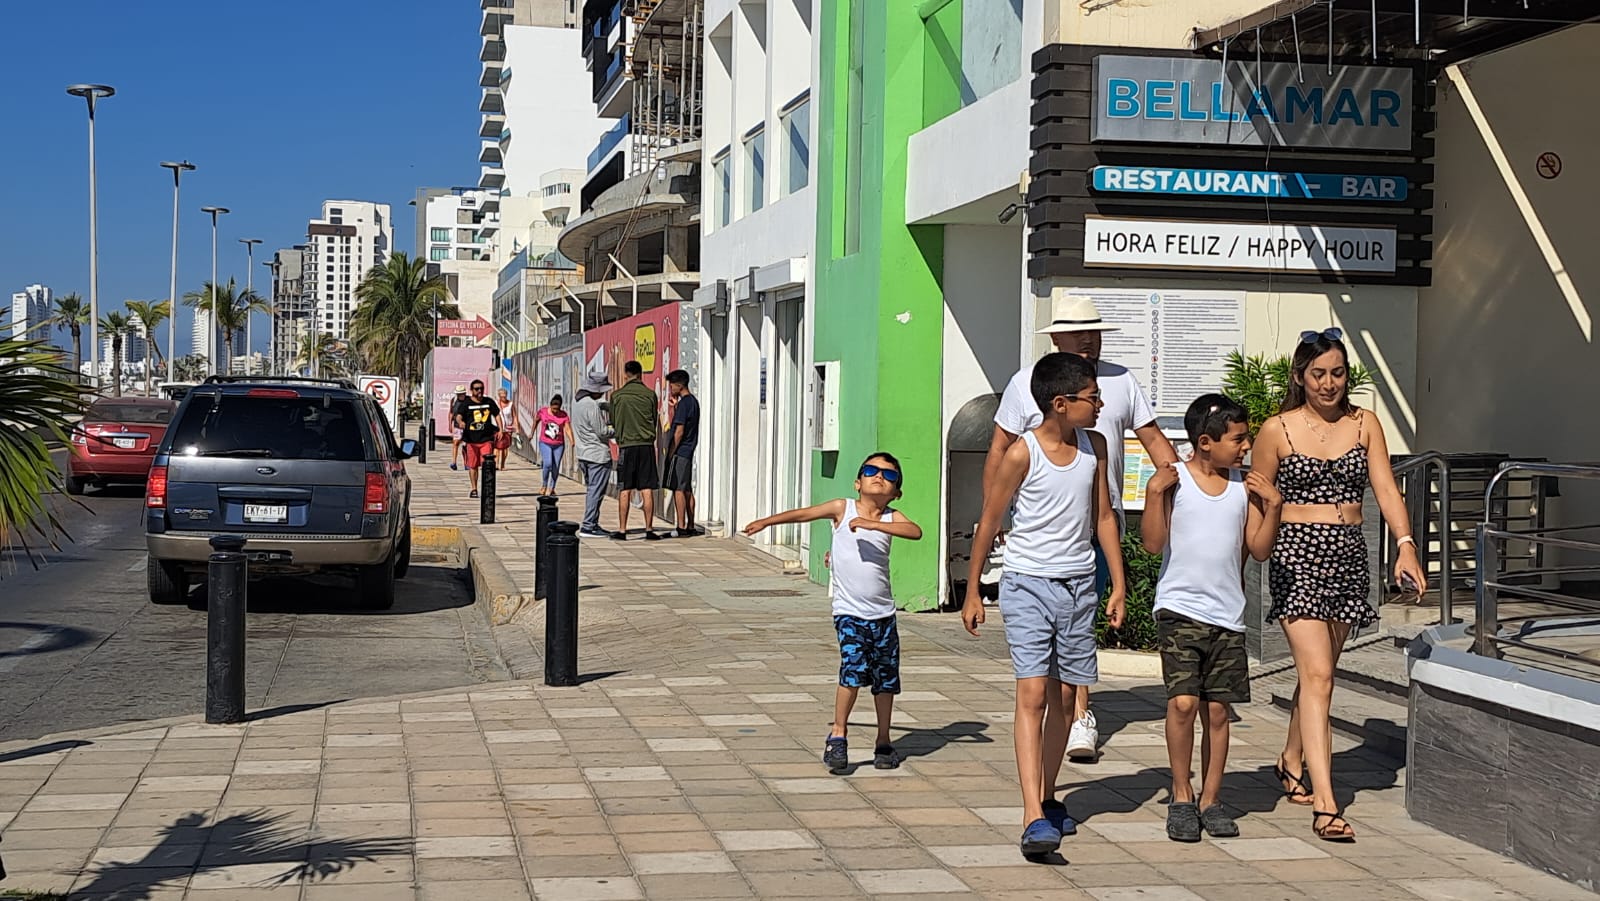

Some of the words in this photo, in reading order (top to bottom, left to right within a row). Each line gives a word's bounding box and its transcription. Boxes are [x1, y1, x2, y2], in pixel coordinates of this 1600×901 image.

[1106, 78, 1402, 127] BELLAMAR
[1104, 169, 1287, 195] RESTAURANT
[1342, 177, 1396, 198] BAR
[1097, 232, 1157, 254] HORA
[1165, 234, 1221, 256] FELIZ
[1228, 236, 1240, 258] /
[1248, 238, 1316, 259] HAPPY
[1324, 239, 1384, 261] HOUR
